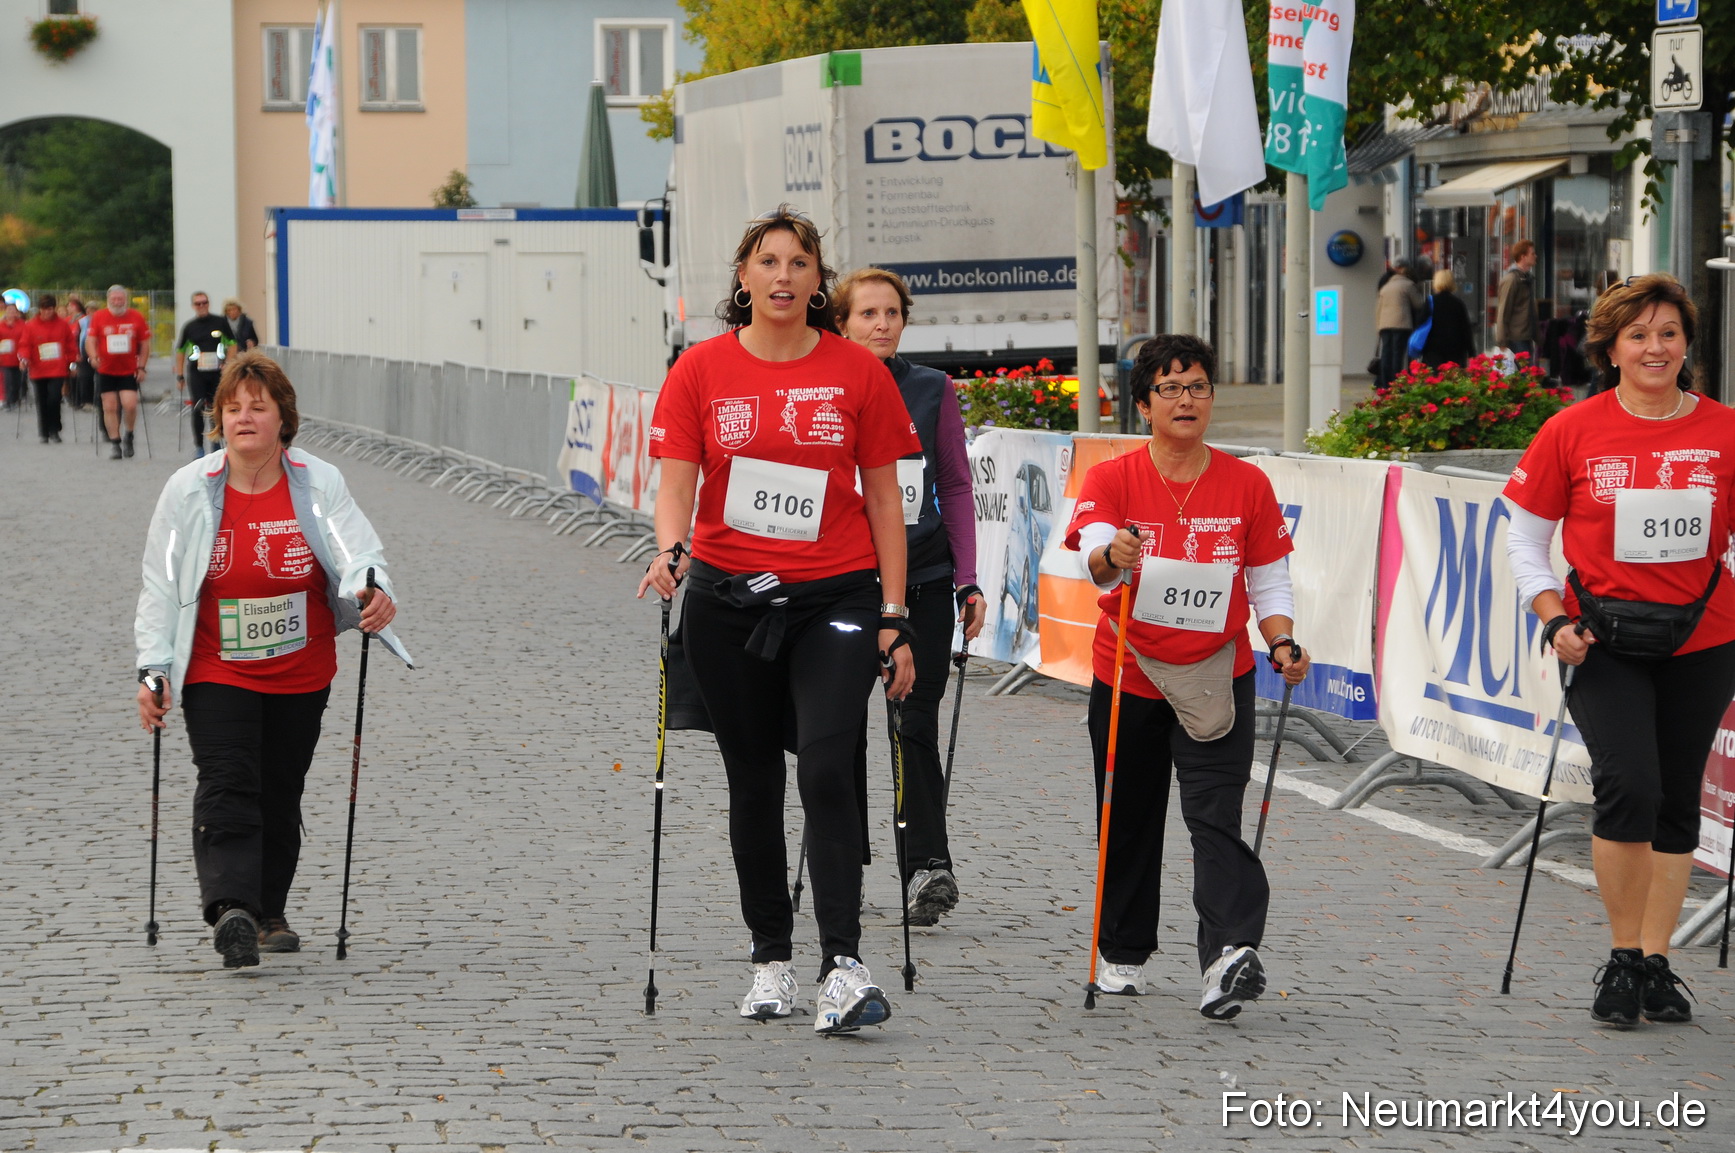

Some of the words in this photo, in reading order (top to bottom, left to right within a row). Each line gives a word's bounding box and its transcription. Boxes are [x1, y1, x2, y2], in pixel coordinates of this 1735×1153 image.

[1670, 38, 1685, 51] nur
[783, 122, 823, 192] BOCK
[880, 175, 944, 187] Entwicklung
[880, 190, 940, 201] Formenbau
[881, 204, 973, 216] Kunststofftechnik
[881, 216, 995, 230] Aluminium-Druckguss
[882, 233, 922, 245] Logistik
[900, 265, 1077, 288] ww.bockonline.de
[775, 389, 787, 397] 11.
[788, 387, 845, 396] NEUMARKTER
[787, 393, 835, 402] STADTLAUF
[717, 404, 751, 415] IMMER
[716, 410, 753, 423] WIEDER
[719, 419, 750, 434] NEU
[720, 430, 751, 443] MARKT
[1652, 451, 1664, 459] 11.
[1664, 448, 1720, 458] NEUMARKTER
[1663, 455, 1710, 464] STADTLAUF
[1594, 462, 1628, 472] IMMER
[1593, 469, 1629, 478] WIEDER
[1595, 476, 1627, 489] NEU
[753, 490, 815, 519] 8106
[248, 522, 259, 530] 11.
[1191, 516, 1242, 526] NEUMARKTER
[1643, 516, 1702, 538] 8108
[776, 525, 808, 536] PFLEIDERER
[1189, 524, 1232, 533] STADTLAUF
[1163, 586, 1223, 609] 8107
[243, 599, 294, 616] Elisabeth
[247, 615, 300, 640] 8065
[1185, 617, 1215, 626] PFLEIDERER
[1410, 715, 1444, 743] MICRO
